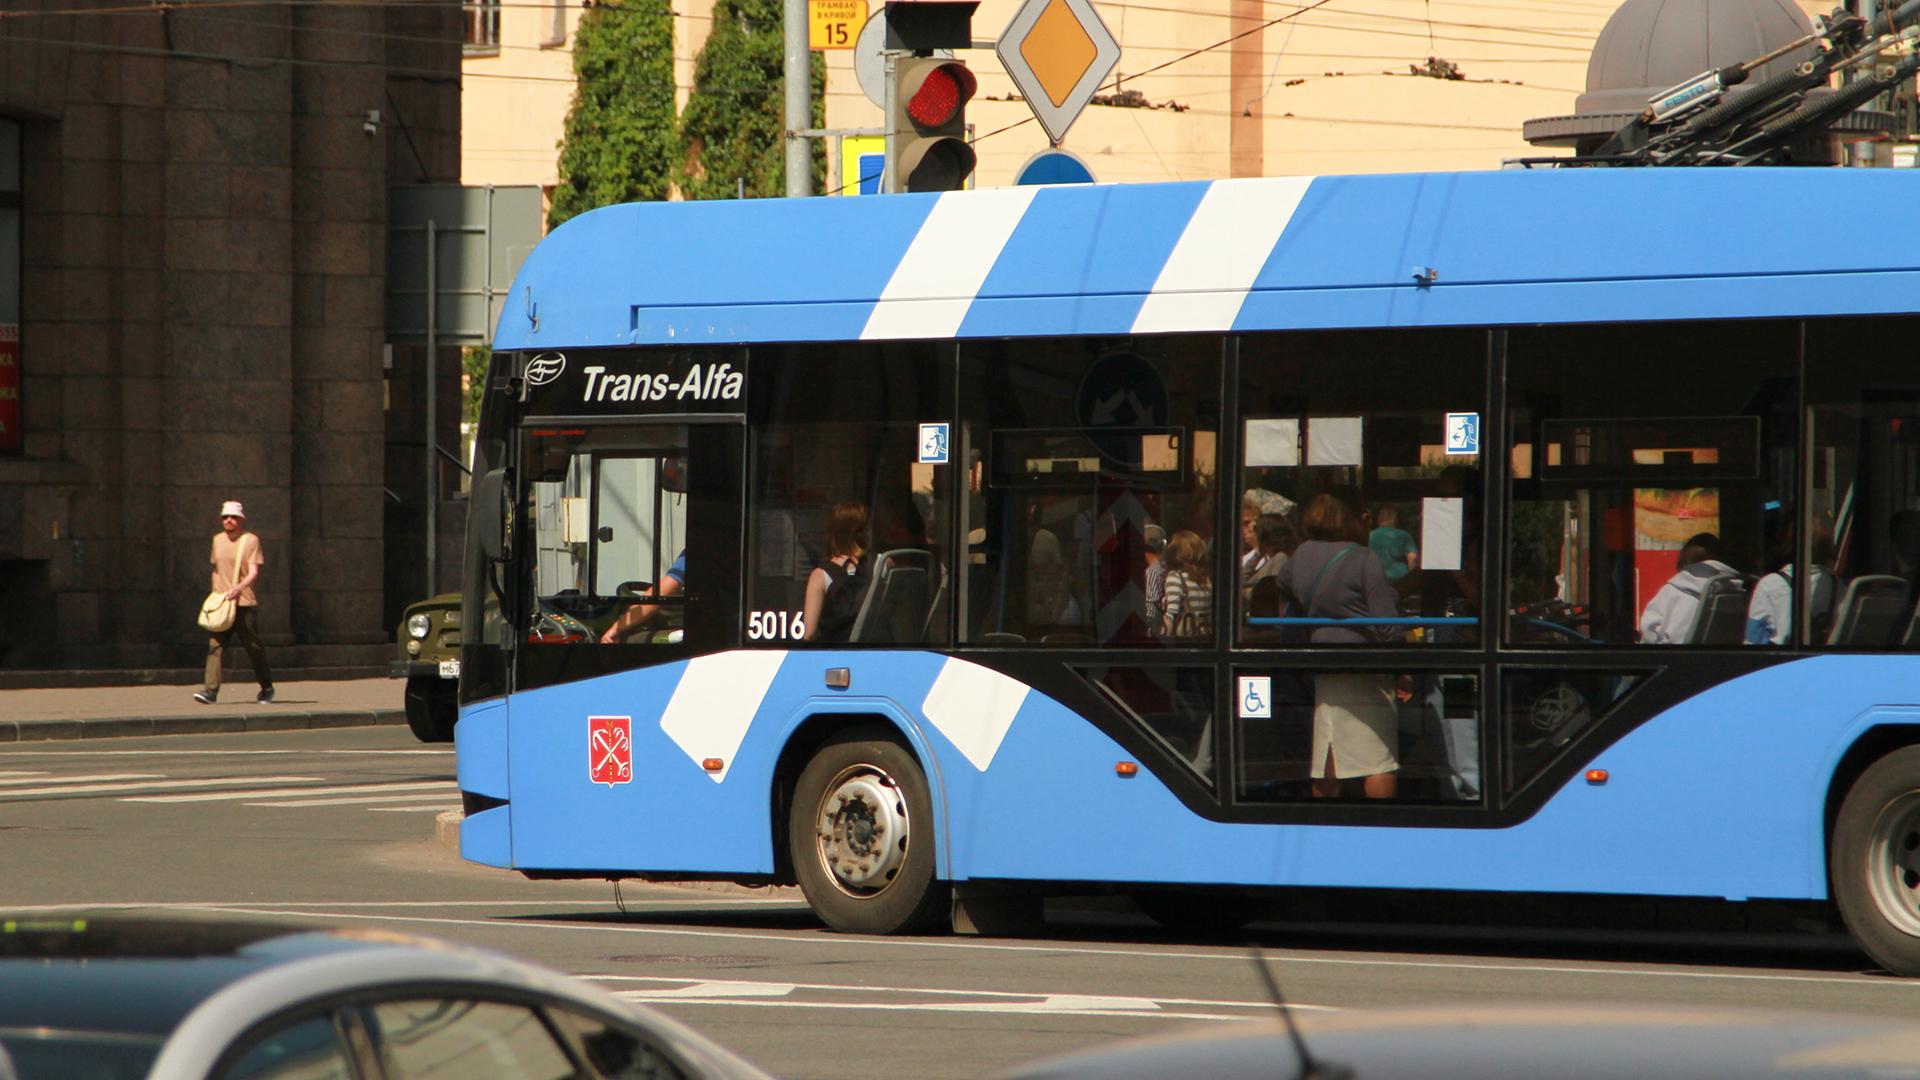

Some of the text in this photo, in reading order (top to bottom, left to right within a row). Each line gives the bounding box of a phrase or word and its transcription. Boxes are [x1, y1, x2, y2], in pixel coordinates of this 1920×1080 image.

[825, 23, 848, 45] 15
[1664, 84, 1705, 107] FESTO
[583, 363, 744, 401] Trans-Alfa
[748, 610, 805, 640] 5016
